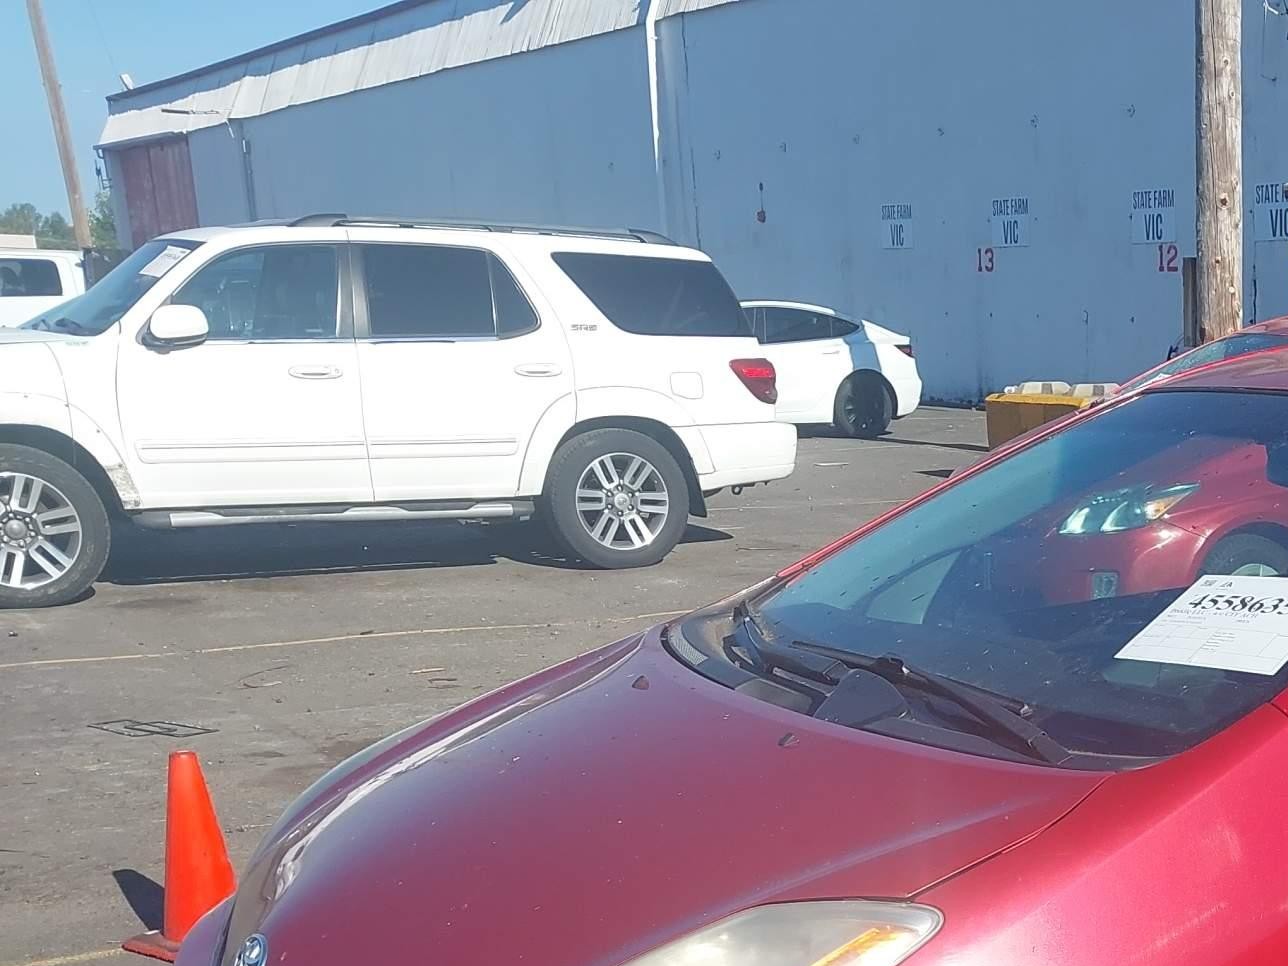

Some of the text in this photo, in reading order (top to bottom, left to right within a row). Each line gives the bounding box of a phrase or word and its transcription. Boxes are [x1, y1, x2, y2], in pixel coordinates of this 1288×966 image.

[1133, 189, 1175, 209] STATE FARM
[1256, 184, 1279, 204] STATE
[881, 203, 912, 220] STATE FARM
[992, 198, 1029, 216] STATE FARM
[890, 224, 904, 246] VIC
[1003, 220, 1018, 244] VIC
[1144, 213, 1162, 240] VIC
[977, 248, 994, 272] 13
[1158, 244, 1179, 272] 12
